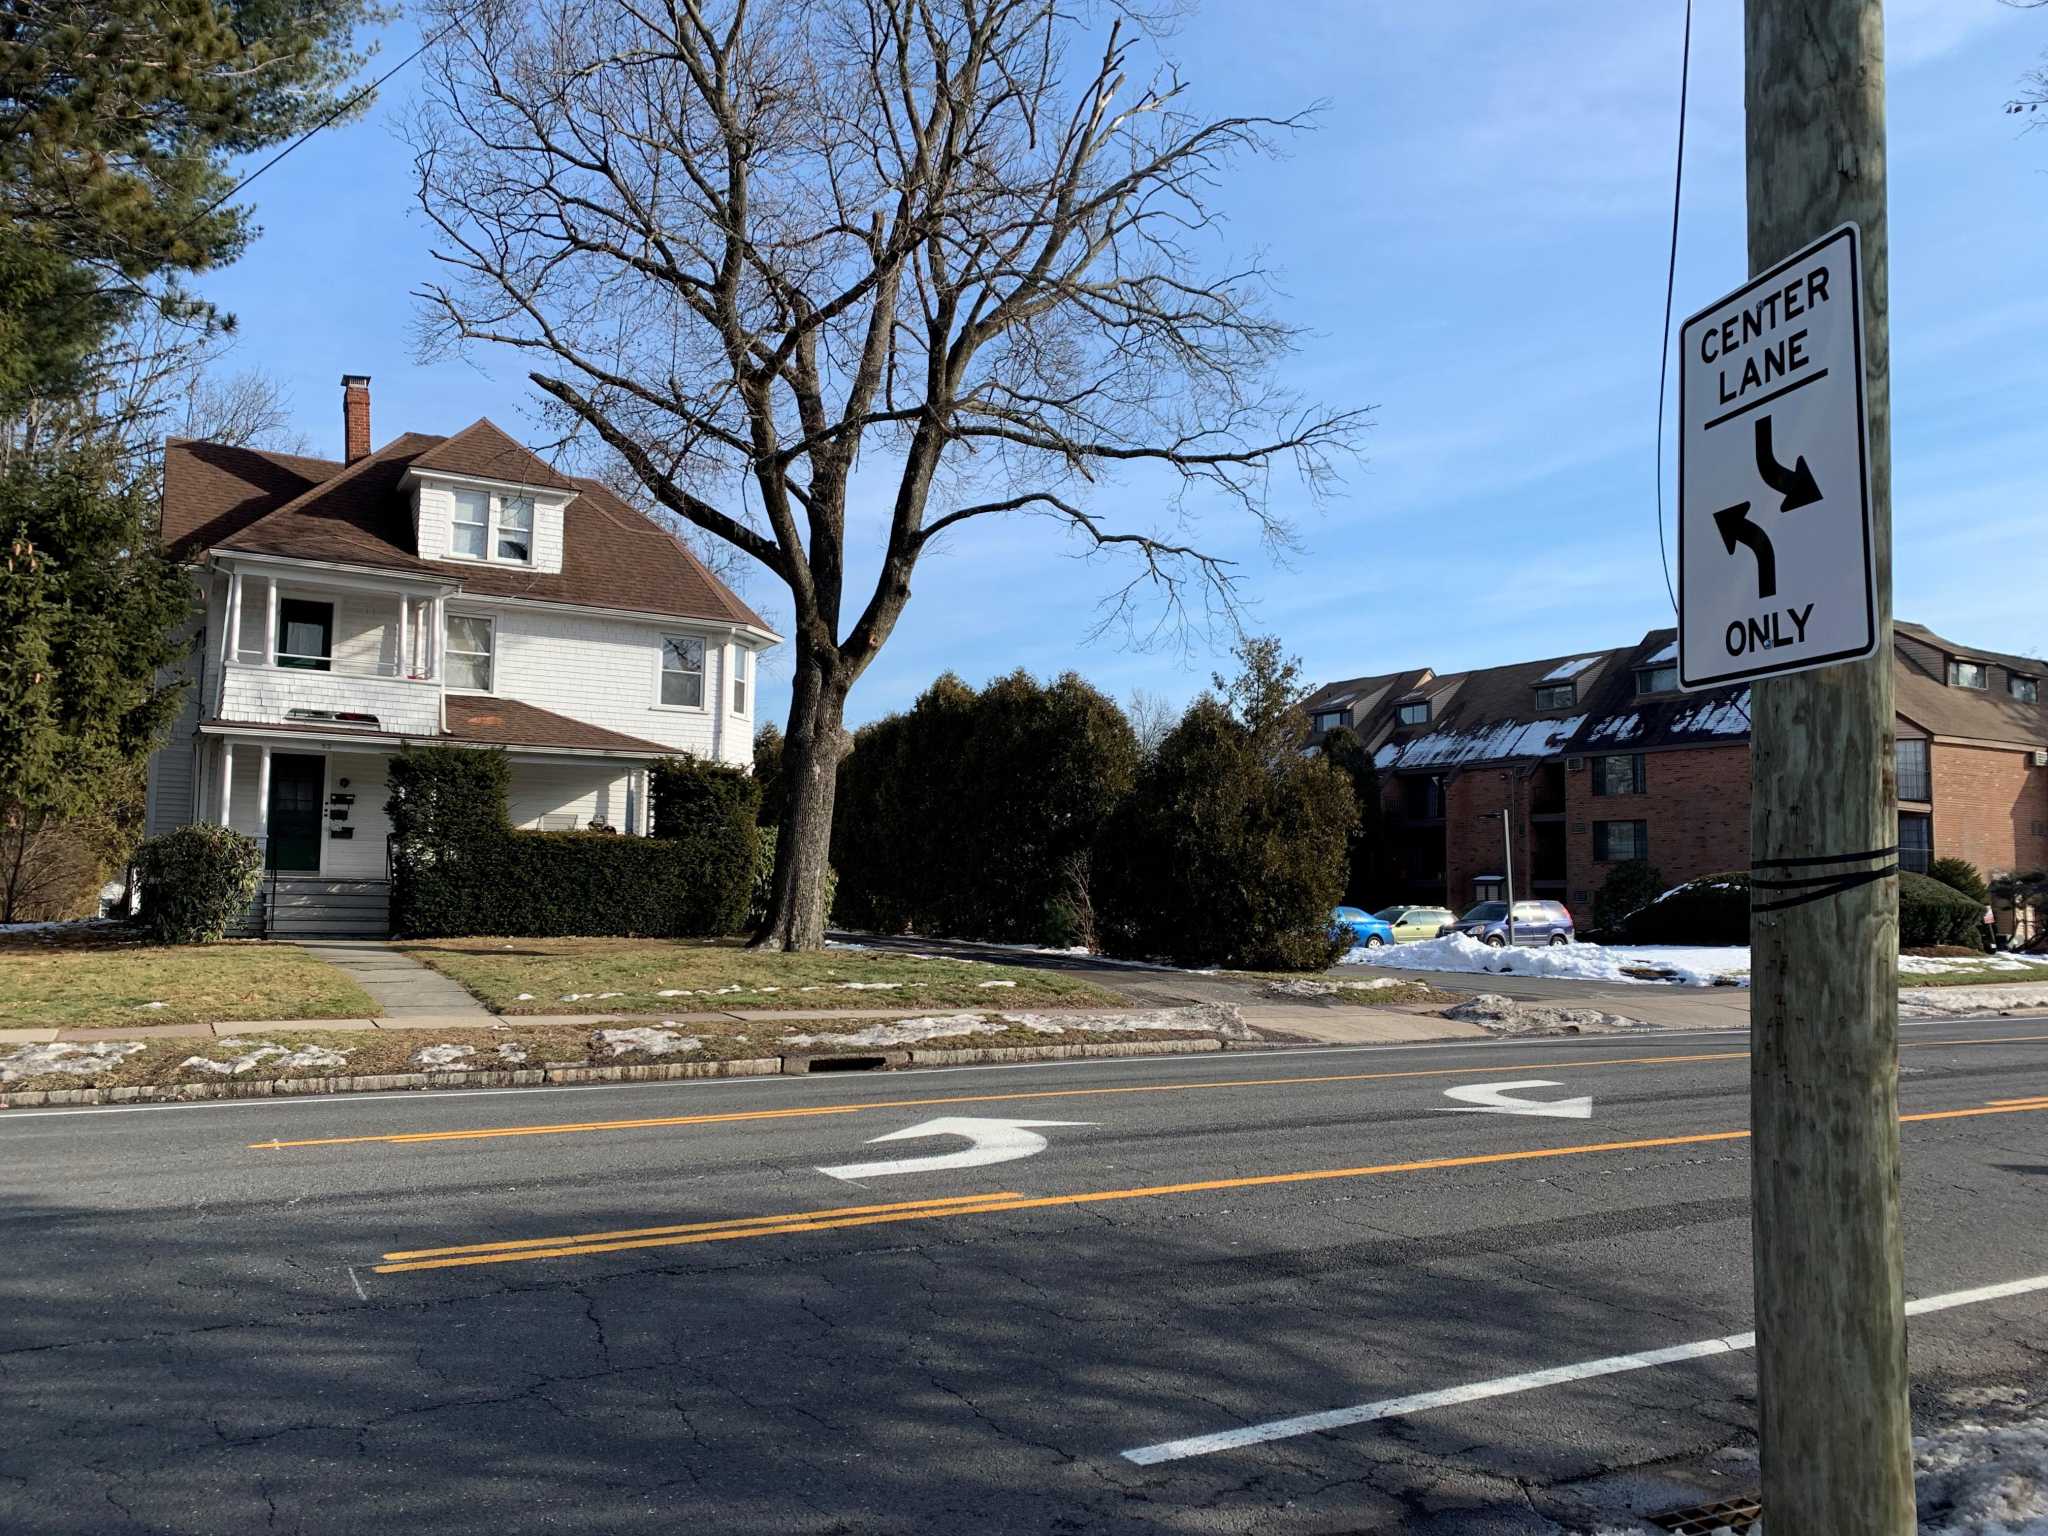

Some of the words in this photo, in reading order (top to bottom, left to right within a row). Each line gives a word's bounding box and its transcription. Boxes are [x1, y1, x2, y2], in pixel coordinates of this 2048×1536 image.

[1701, 266, 1830, 364] CENTER
[1719, 328, 1810, 405] LANE
[1725, 603, 1814, 657] ONLY
